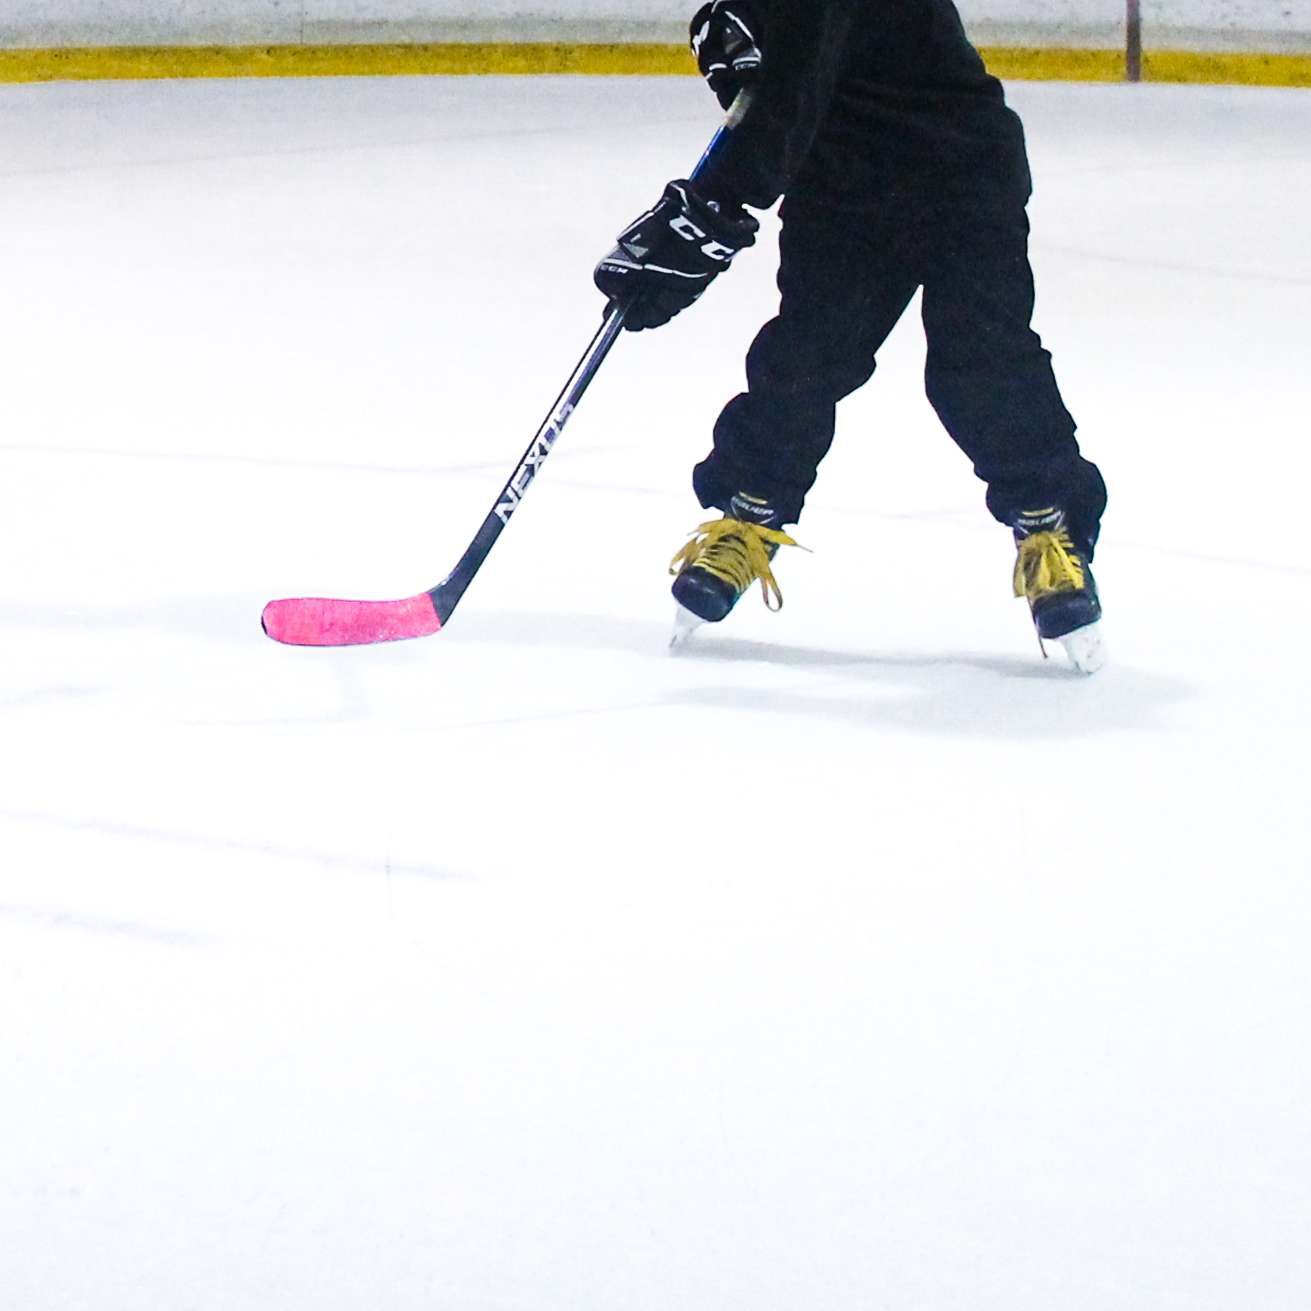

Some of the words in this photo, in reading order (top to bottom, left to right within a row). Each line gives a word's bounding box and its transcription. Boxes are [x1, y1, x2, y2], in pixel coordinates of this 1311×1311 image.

[669, 214, 735, 263] CC
[600, 264, 629, 274] CCM
[494, 402, 575, 526] NEXUS
